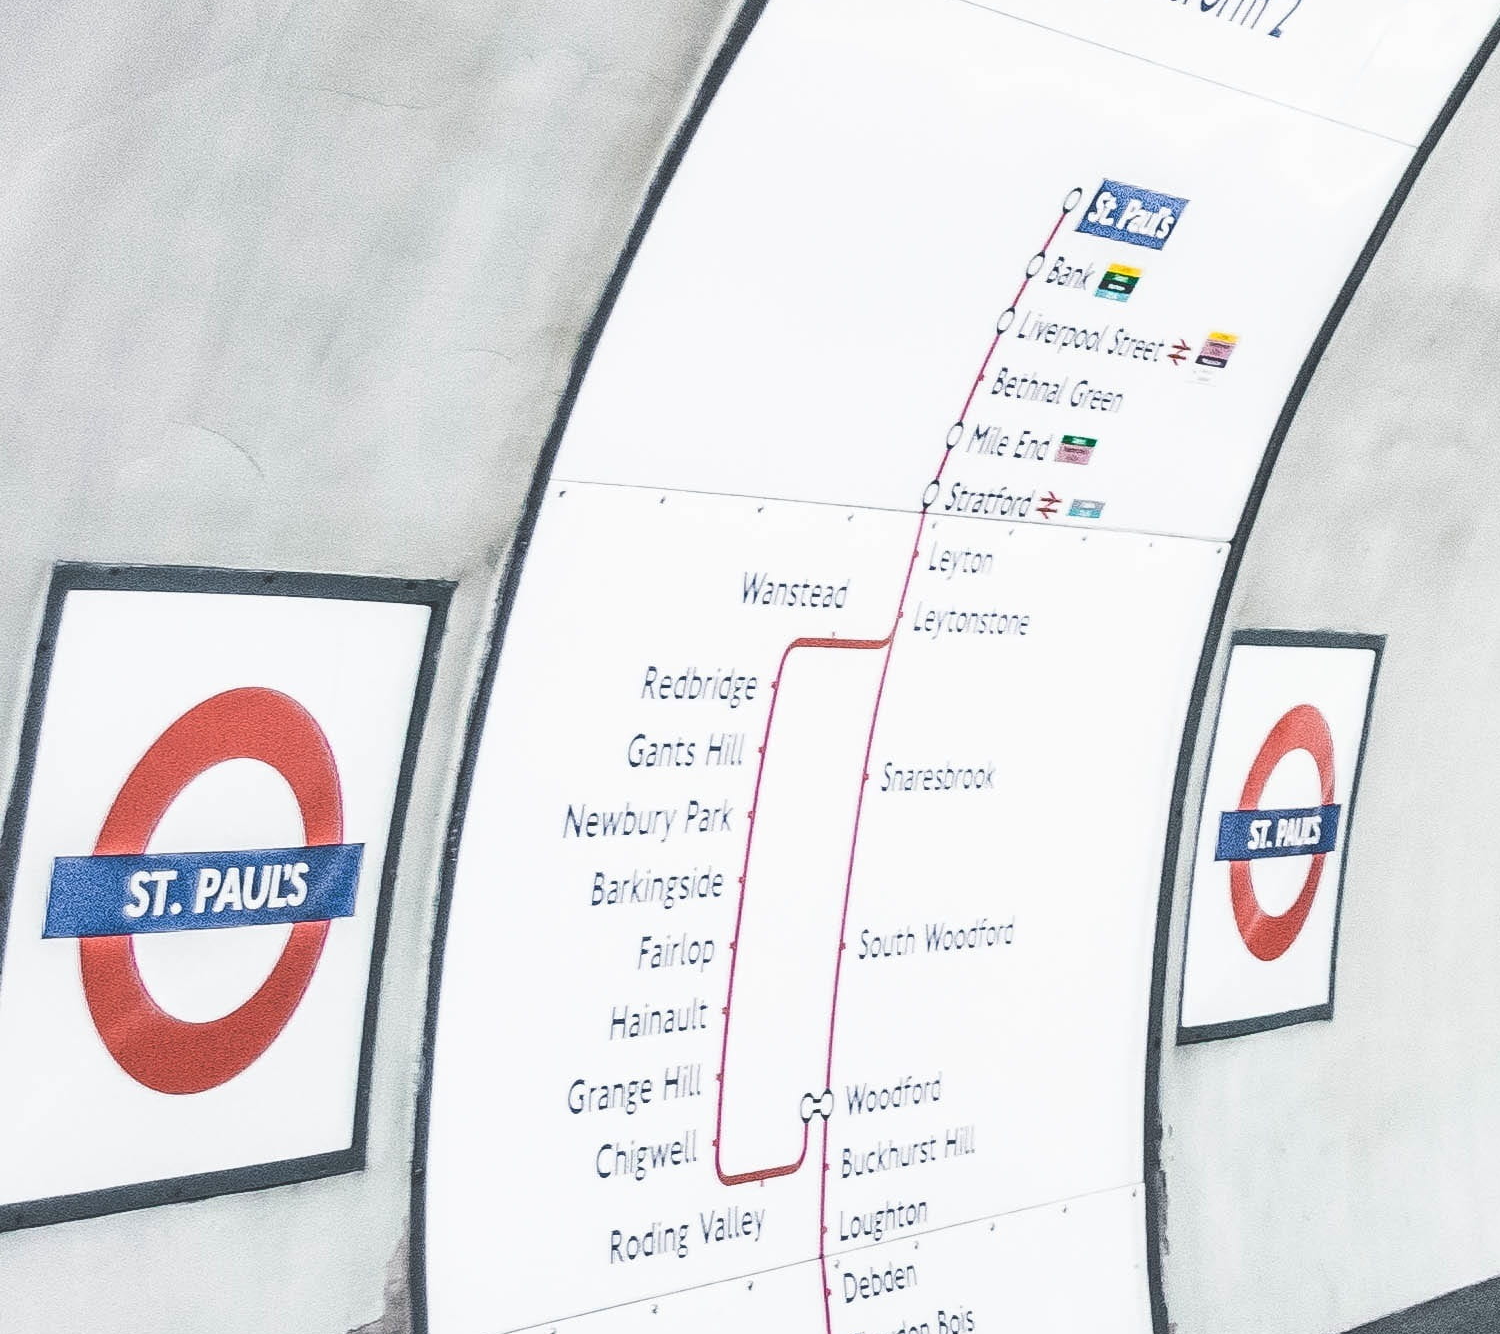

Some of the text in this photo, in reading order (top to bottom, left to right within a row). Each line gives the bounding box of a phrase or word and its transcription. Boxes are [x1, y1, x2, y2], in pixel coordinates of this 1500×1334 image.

[1046, 256, 1095, 291] Bank
[1016, 310, 1110, 354] Liverpool
[1106, 327, 1165, 363] Street
[991, 367, 1123, 413] Bethnal Green
[967, 423, 1009, 457] Mile
[1013, 430, 1053, 460] End
[945, 481, 1035, 517] Stratford
[928, 540, 994, 580] Leyton
[742, 572, 850, 608] Wanstead
[913, 601, 1031, 640] Leytonstone
[641, 666, 758, 708] Redbridge
[628, 732, 746, 767] Gants Hill
[881, 759, 996, 792] Snaresbrook
[562, 799, 733, 843] Newbury Park
[1247, 815, 1323, 851] ST. PAUL'S
[124, 861, 310, 919] ST. PAUL'S
[589, 865, 725, 909] Barkingside
[637, 932, 716, 972] Fairlop
[858, 915, 1016, 960] South Woodford
[609, 998, 710, 1040] Hainault
[567, 1063, 702, 1115] Grange Hill
[846, 1071, 943, 1116] Woodford
[596, 1129, 698, 1181] Chigwell
[841, 1124, 976, 1179] Buckhurst Hill
[609, 1205, 767, 1264] Roding Valley
[839, 1198, 929, 1242] Loughton
[843, 1261, 918, 1304] Debden
